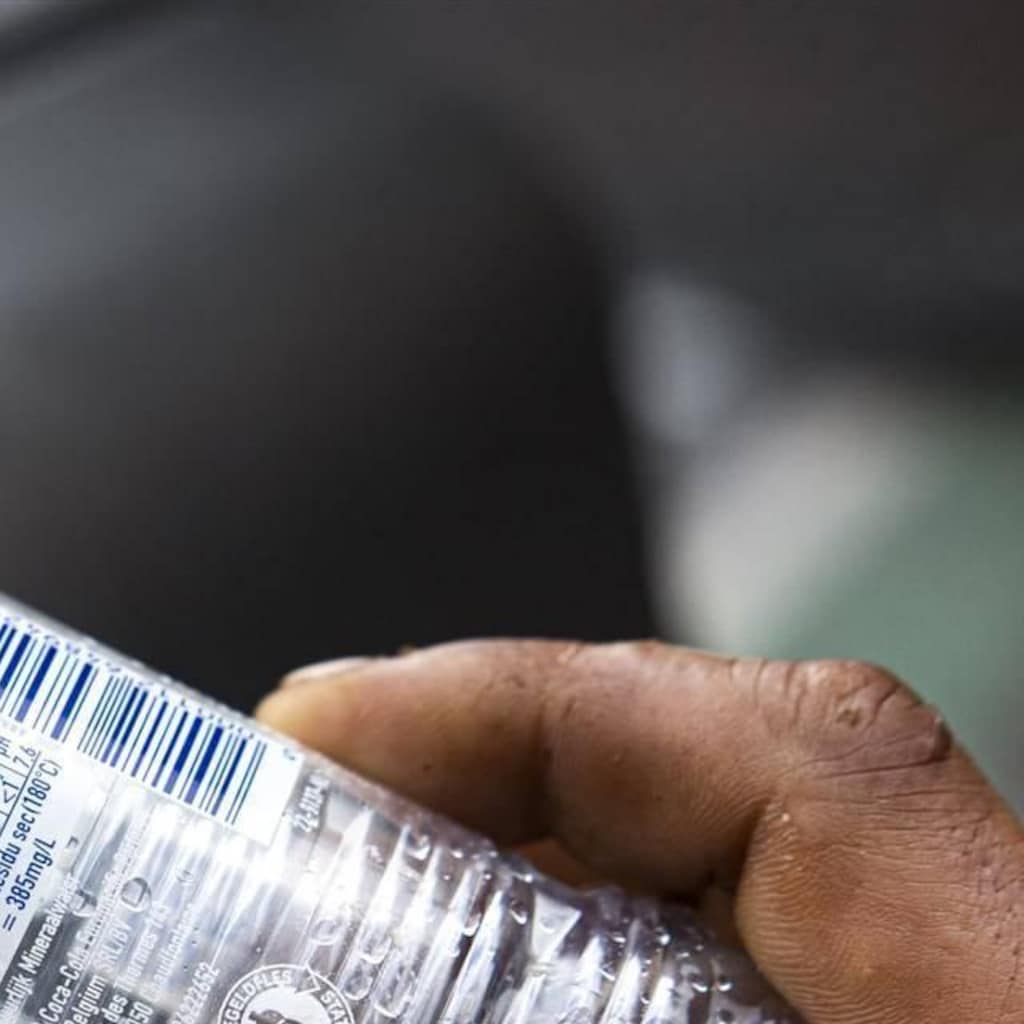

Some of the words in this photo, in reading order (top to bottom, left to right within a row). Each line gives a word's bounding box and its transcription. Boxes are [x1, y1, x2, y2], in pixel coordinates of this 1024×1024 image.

[3, 780, 19, 803] <1
[5, 832, 56, 911] 385mg/L
[38, 942, 89, 1024] Coca-Cola
[99, 992, 128, 1024] des
